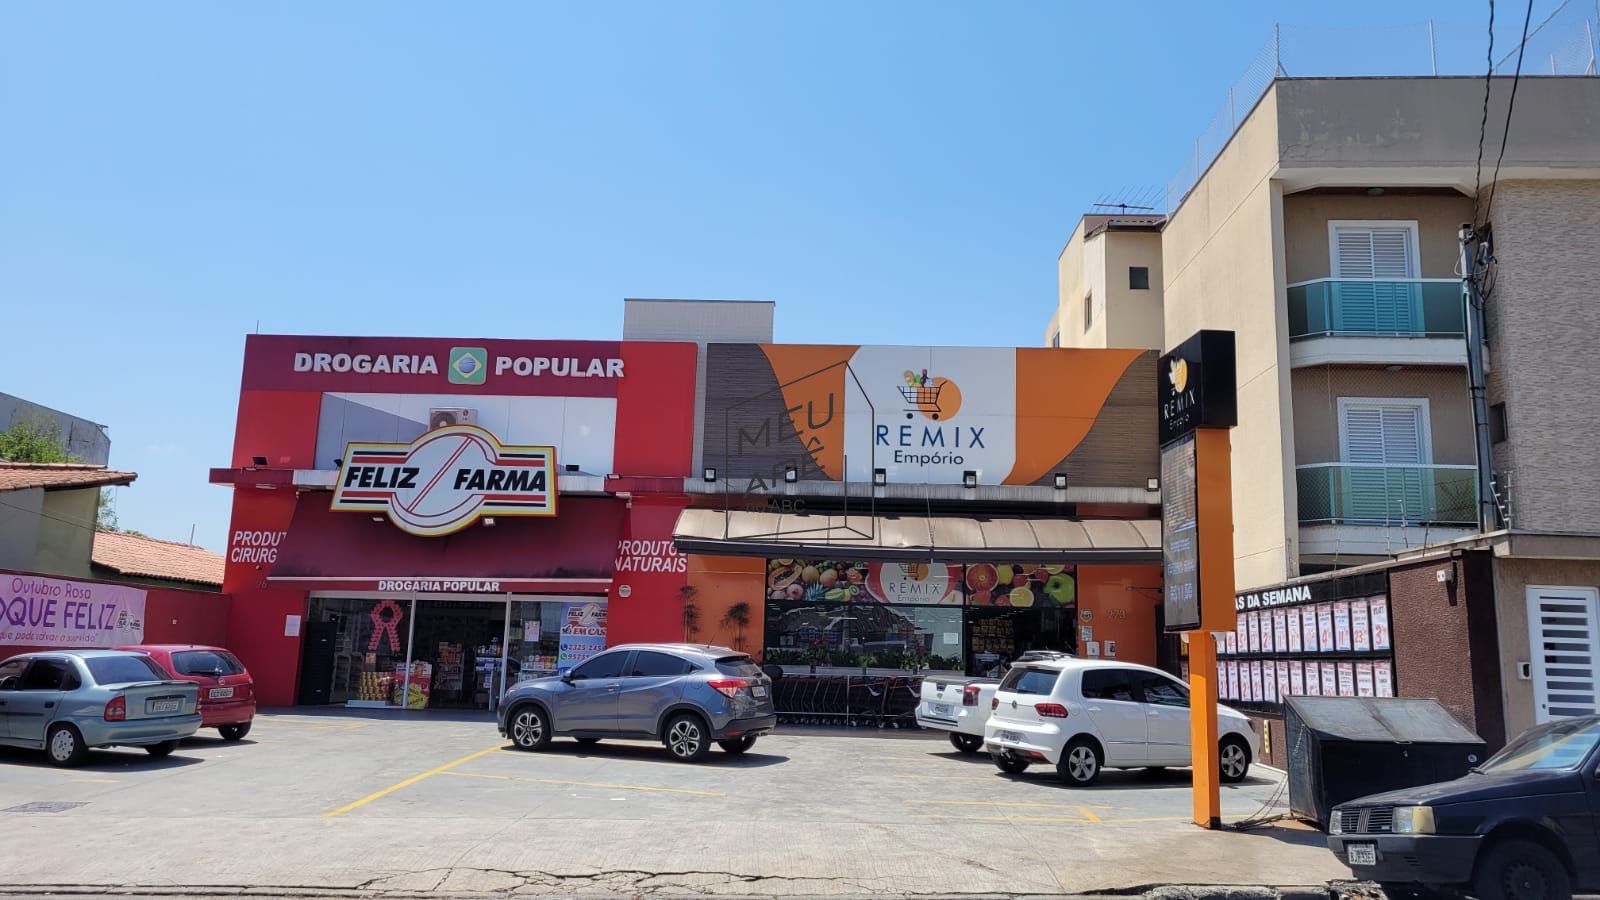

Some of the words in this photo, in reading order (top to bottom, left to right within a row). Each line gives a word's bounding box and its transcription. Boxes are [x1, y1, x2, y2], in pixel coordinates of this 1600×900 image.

[293, 353, 439, 375] DROGARIA
[495, 356, 625, 378] POPULAR
[1165, 387, 1195, 420] REMIX
[876, 425, 985, 449] REMIX
[894, 450, 964, 467] Empório
[343, 467, 420, 489] FELIZ
[453, 469, 546, 492] FARMA
[231, 547, 278, 564] CIRURG
[618, 540, 687, 557] RODUTO
[12, 577, 62, 597] Outubro
[64, 583, 92, 600] Rosa
[378, 580, 441, 591] DROGARIA
[443, 581, 500, 592] POPULAR
[889, 582, 940, 594] REMIX
[1247, 594, 1260, 609] DA
[1262, 585, 1312, 606] SEMANA
[63, 601, 117, 630] FELIZ
